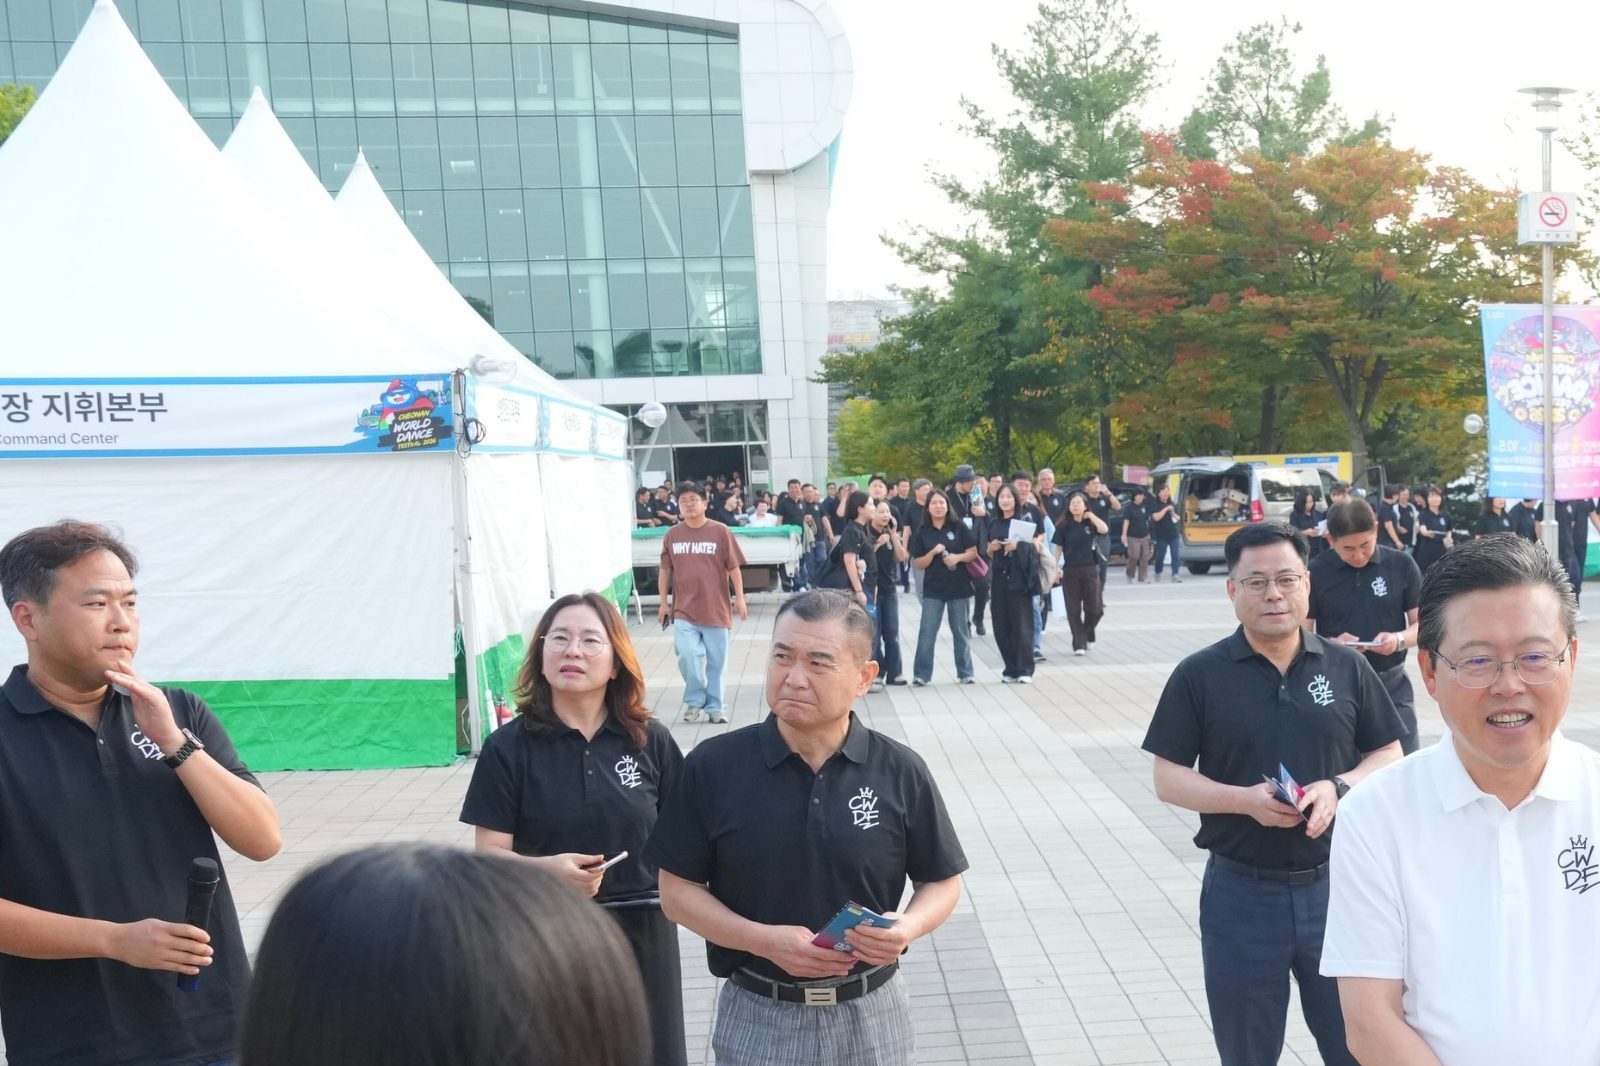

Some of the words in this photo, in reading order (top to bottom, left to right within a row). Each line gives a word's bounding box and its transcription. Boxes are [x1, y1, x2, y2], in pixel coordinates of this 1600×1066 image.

[42, 391, 168, 423] 지휘본부
[393, 418, 431, 433] WORLD
[70, 433, 119, 444] Center
[397, 428, 434, 443] DANCE
[672, 542, 690, 555] WHY
[691, 541, 717, 556] HATE?
[848, 795, 878, 811] CW
[851, 810, 879, 825] DF
[1557, 845, 1595, 869] CW
[1562, 864, 1599, 890] DF
